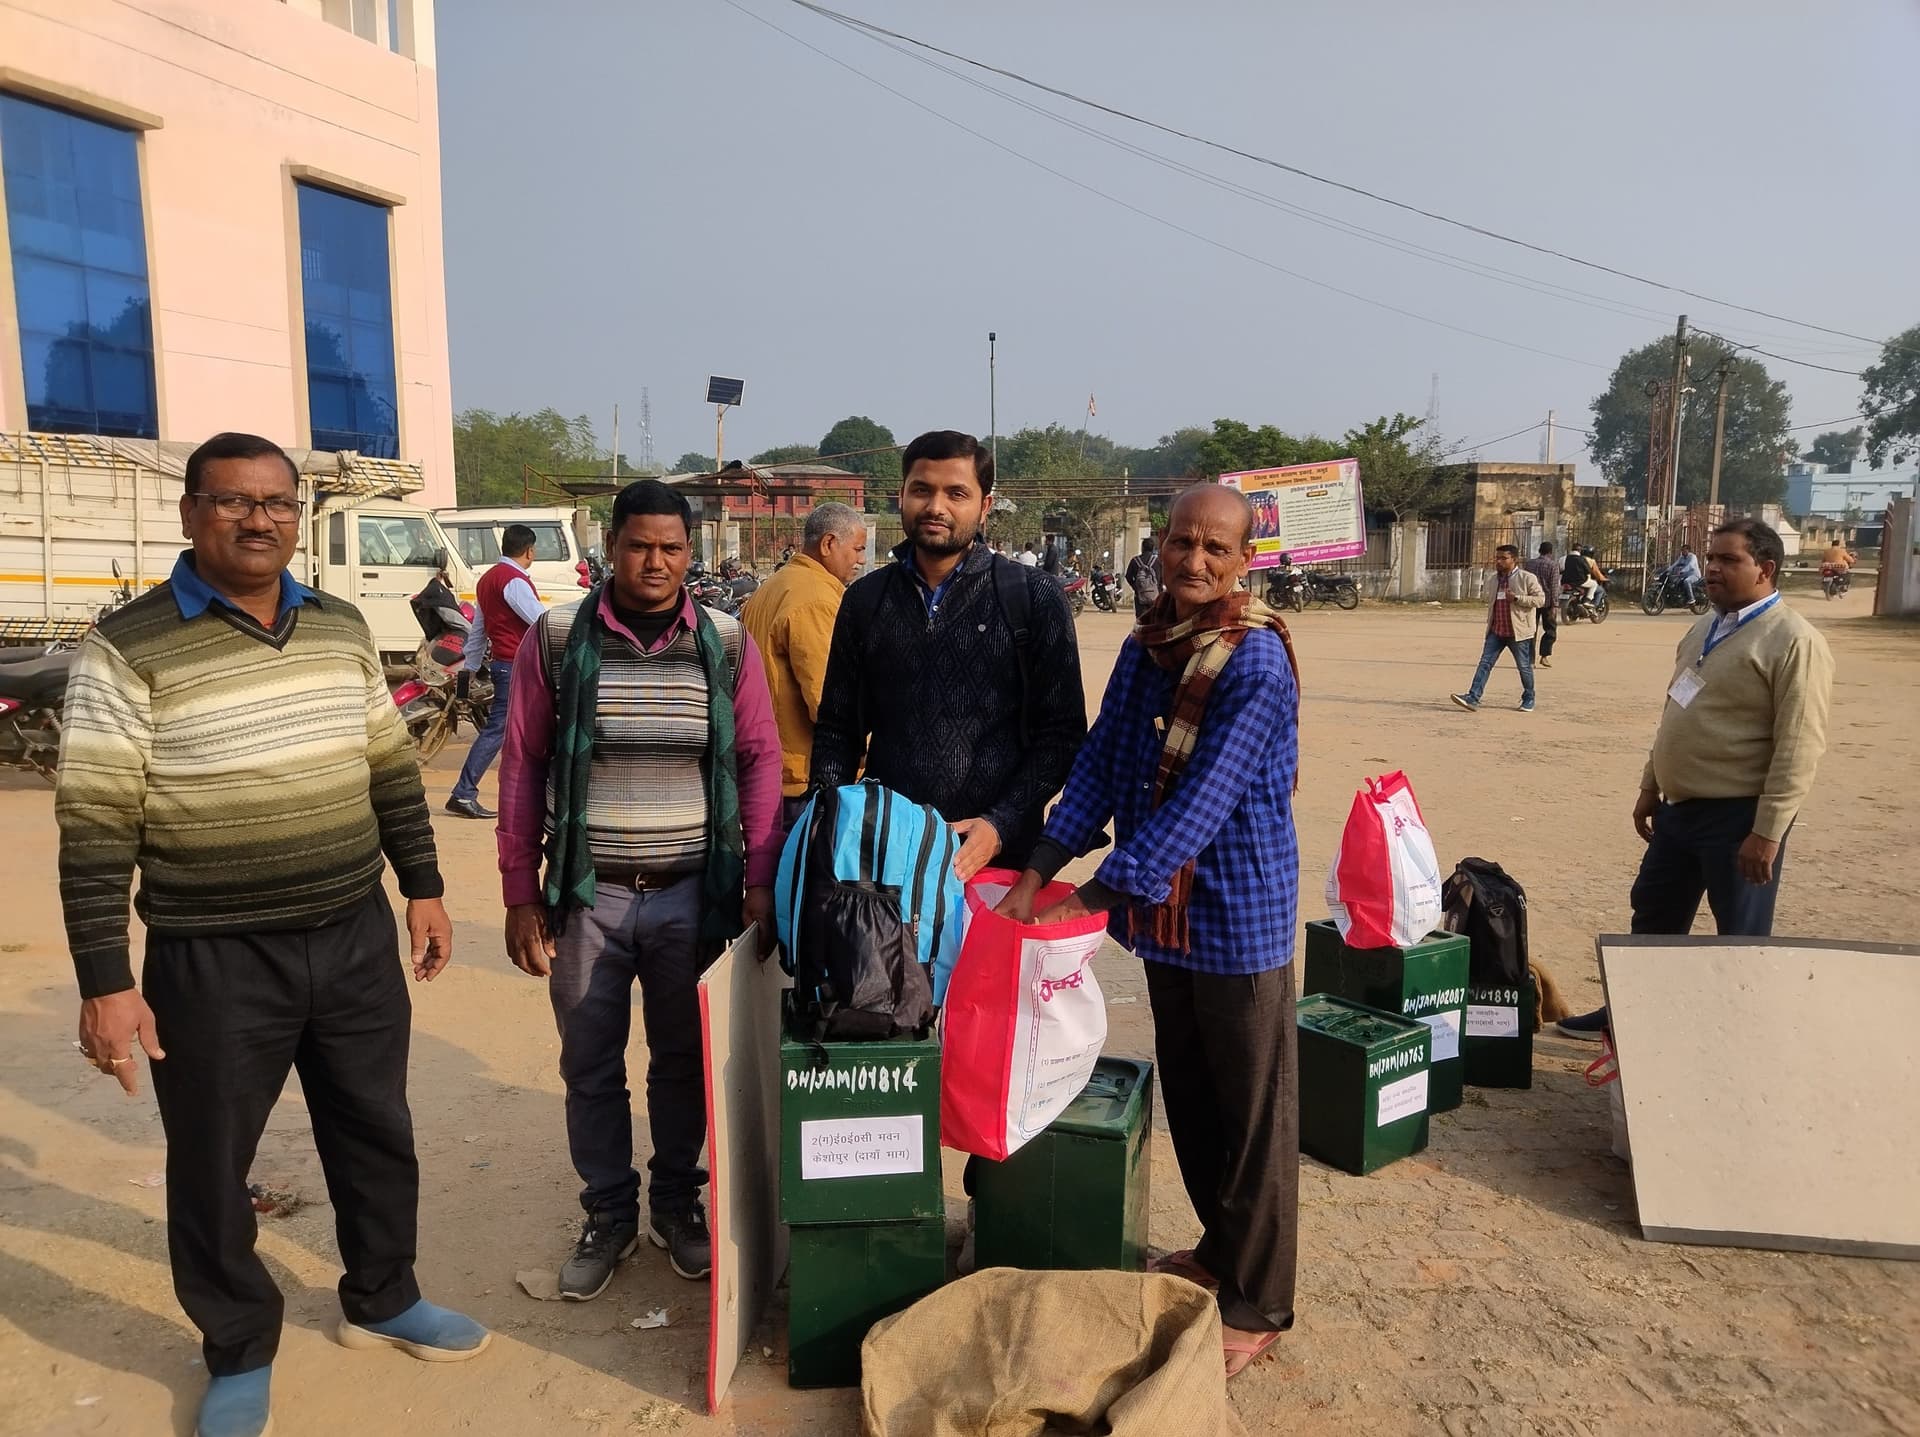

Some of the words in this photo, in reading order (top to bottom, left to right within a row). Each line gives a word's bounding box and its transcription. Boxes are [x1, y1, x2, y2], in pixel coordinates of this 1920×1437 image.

[1403, 987, 1465, 1015] BH/JAM/02087
[1369, 1044, 1424, 1079] BH/JAM/00763
[787, 1065, 918, 1094] BH/JAM/01814
[812, 1151, 849, 1165] केशोपुर
